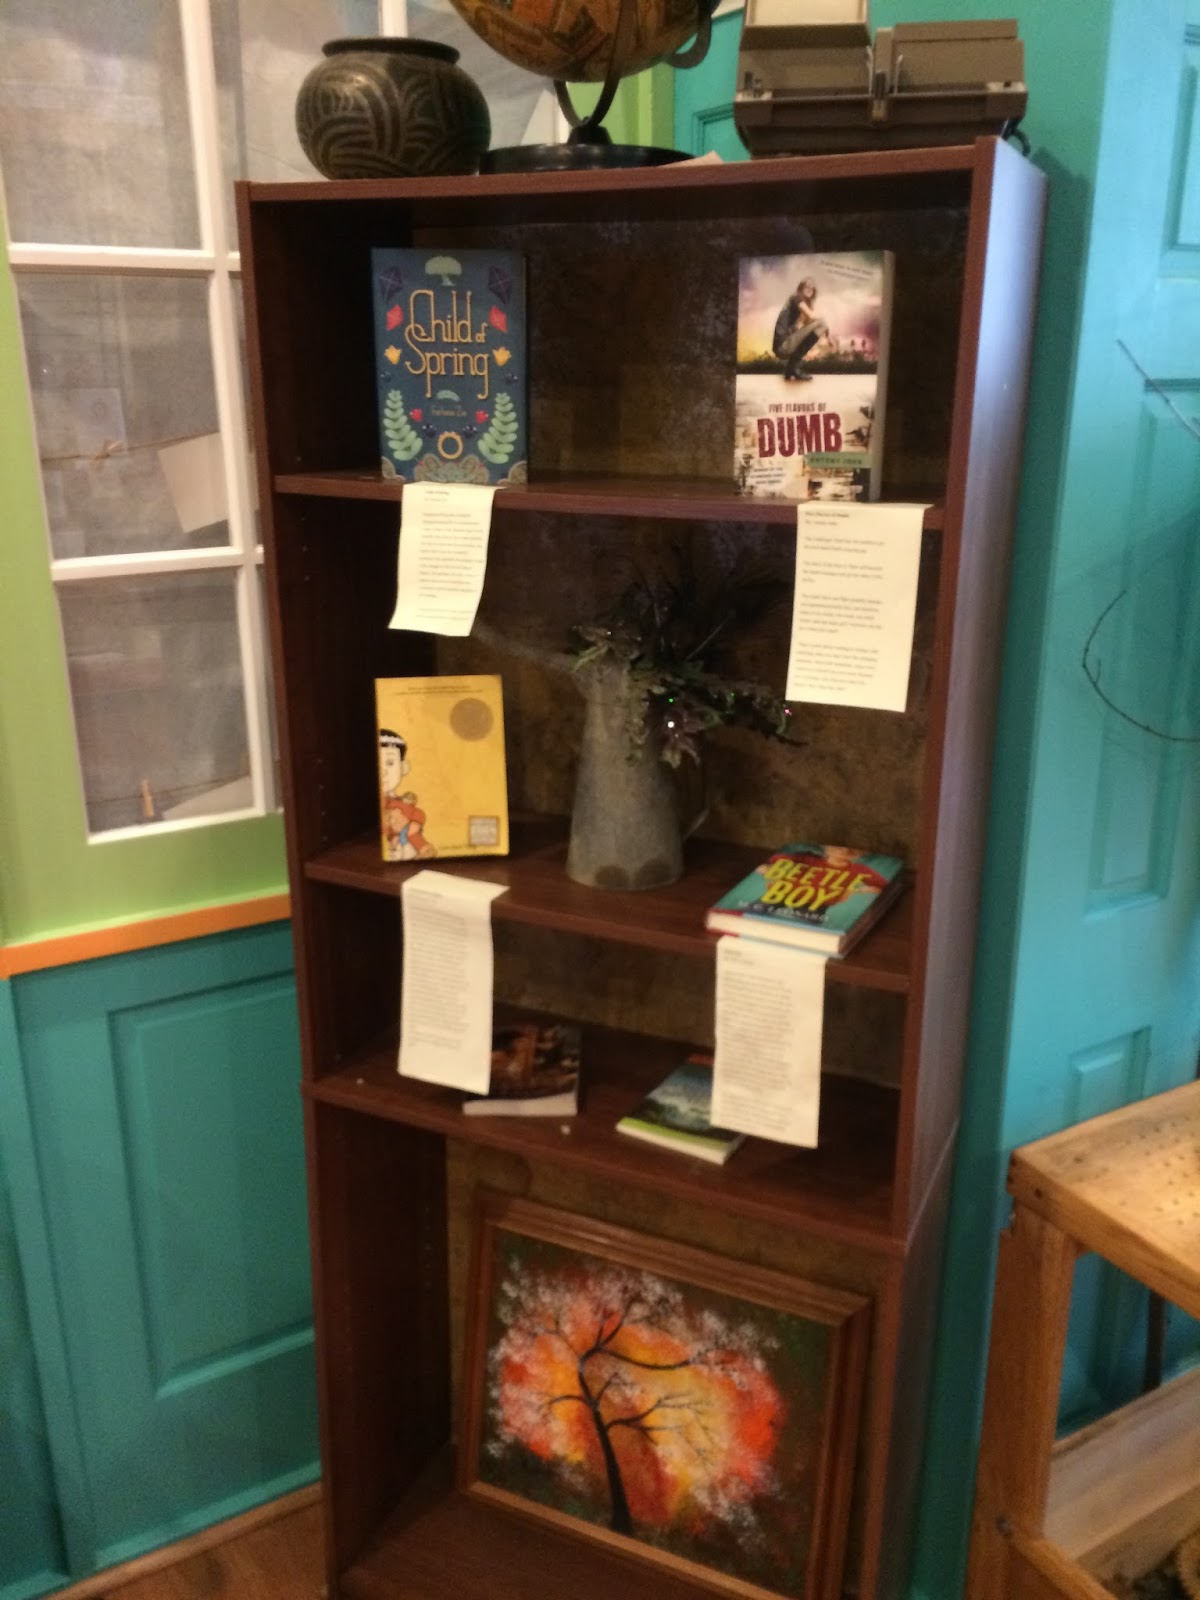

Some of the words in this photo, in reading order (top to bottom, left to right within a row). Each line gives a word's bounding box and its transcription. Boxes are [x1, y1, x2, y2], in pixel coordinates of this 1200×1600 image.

[410, 289, 473, 343] Child
[475, 322, 488, 343] of
[404, 322, 490, 400] Spring
[769, 403, 783, 413] FIVE
[817, 402, 826, 412] OF
[757, 412, 843, 458] DUMB
[763, 857, 872, 892] BEETLE
[760, 880, 841, 912] BOY
